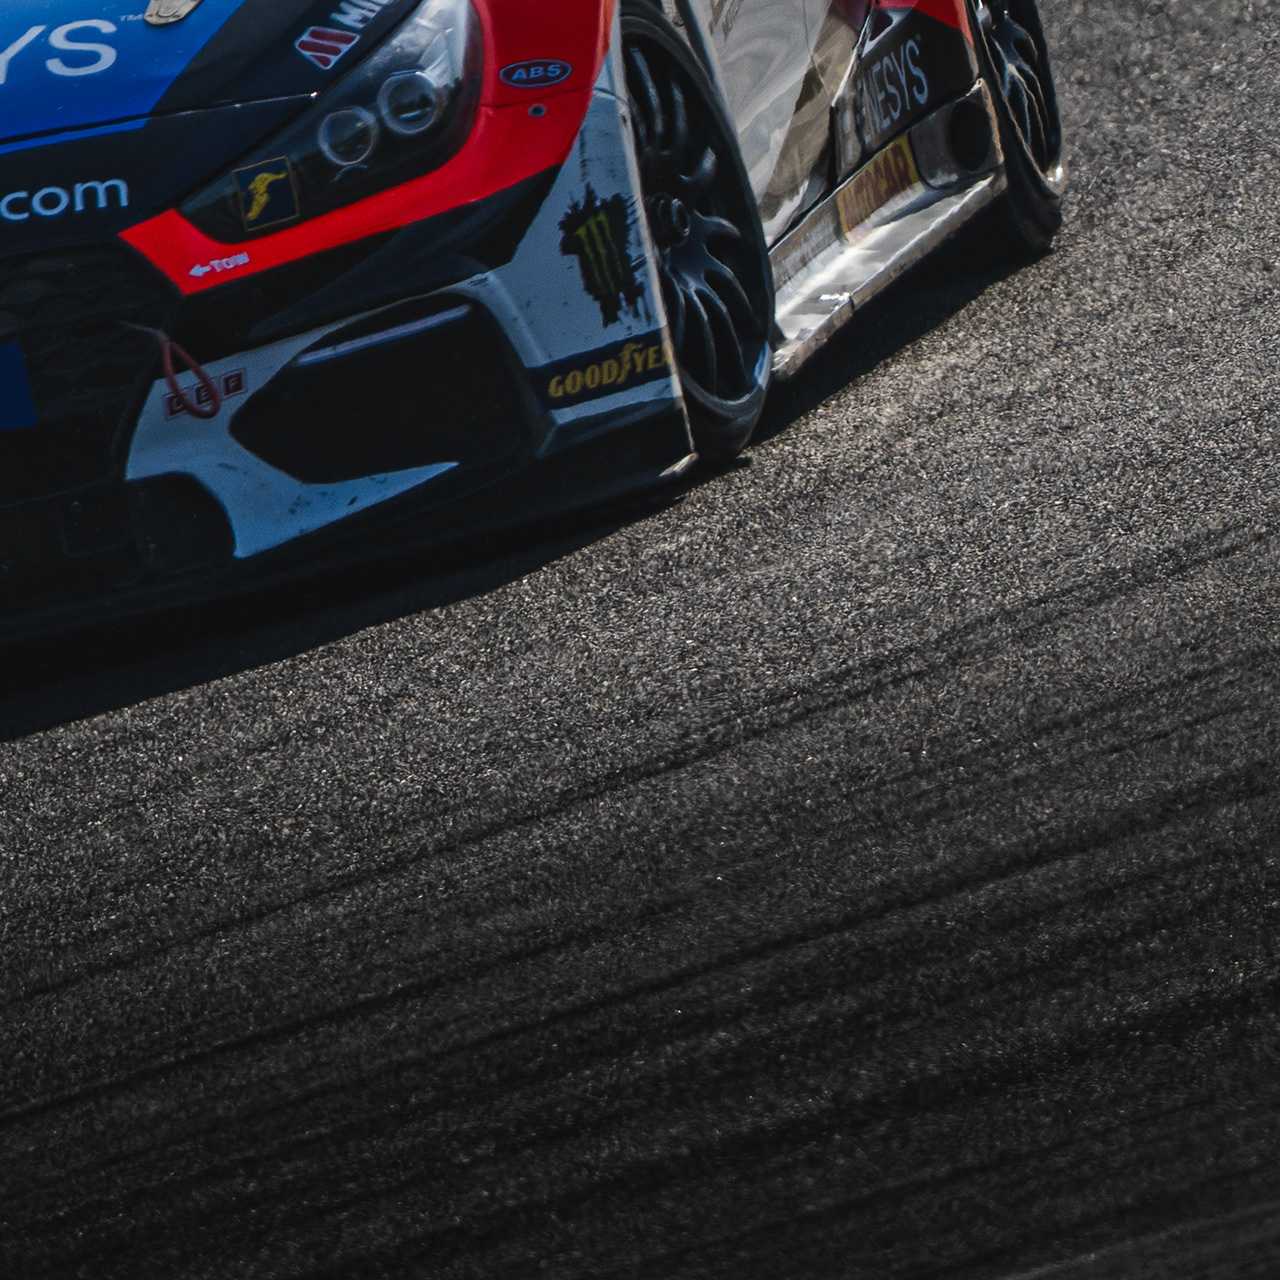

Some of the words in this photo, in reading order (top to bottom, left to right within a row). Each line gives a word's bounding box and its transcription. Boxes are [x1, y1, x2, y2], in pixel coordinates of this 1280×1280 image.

[511, 64, 561, 81] ABS
[210, 251, 250, 273] TOW
[548, 342, 668, 398] GOODYE
